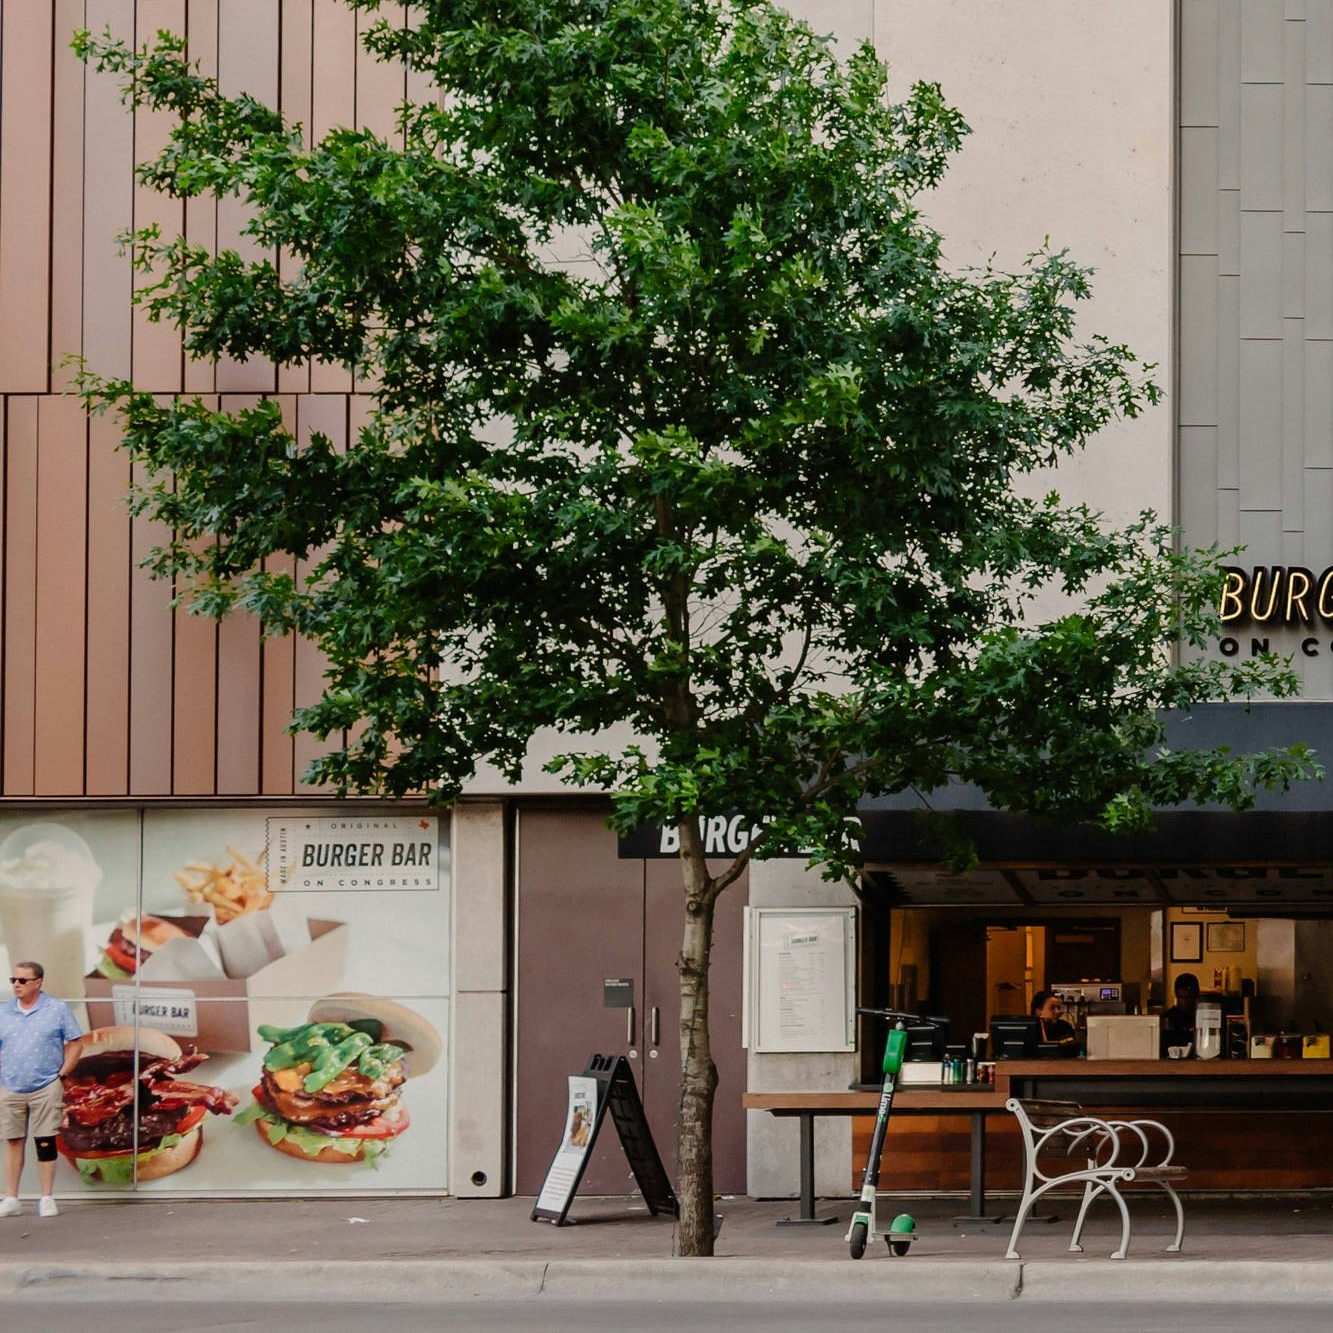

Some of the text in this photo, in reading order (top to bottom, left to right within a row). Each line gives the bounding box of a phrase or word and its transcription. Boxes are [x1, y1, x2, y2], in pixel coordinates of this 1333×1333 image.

[1219, 637, 1270, 657] ON
[302, 843, 432, 867] BURGER BAR
[304, 879, 432, 887] ON CONGRESS
